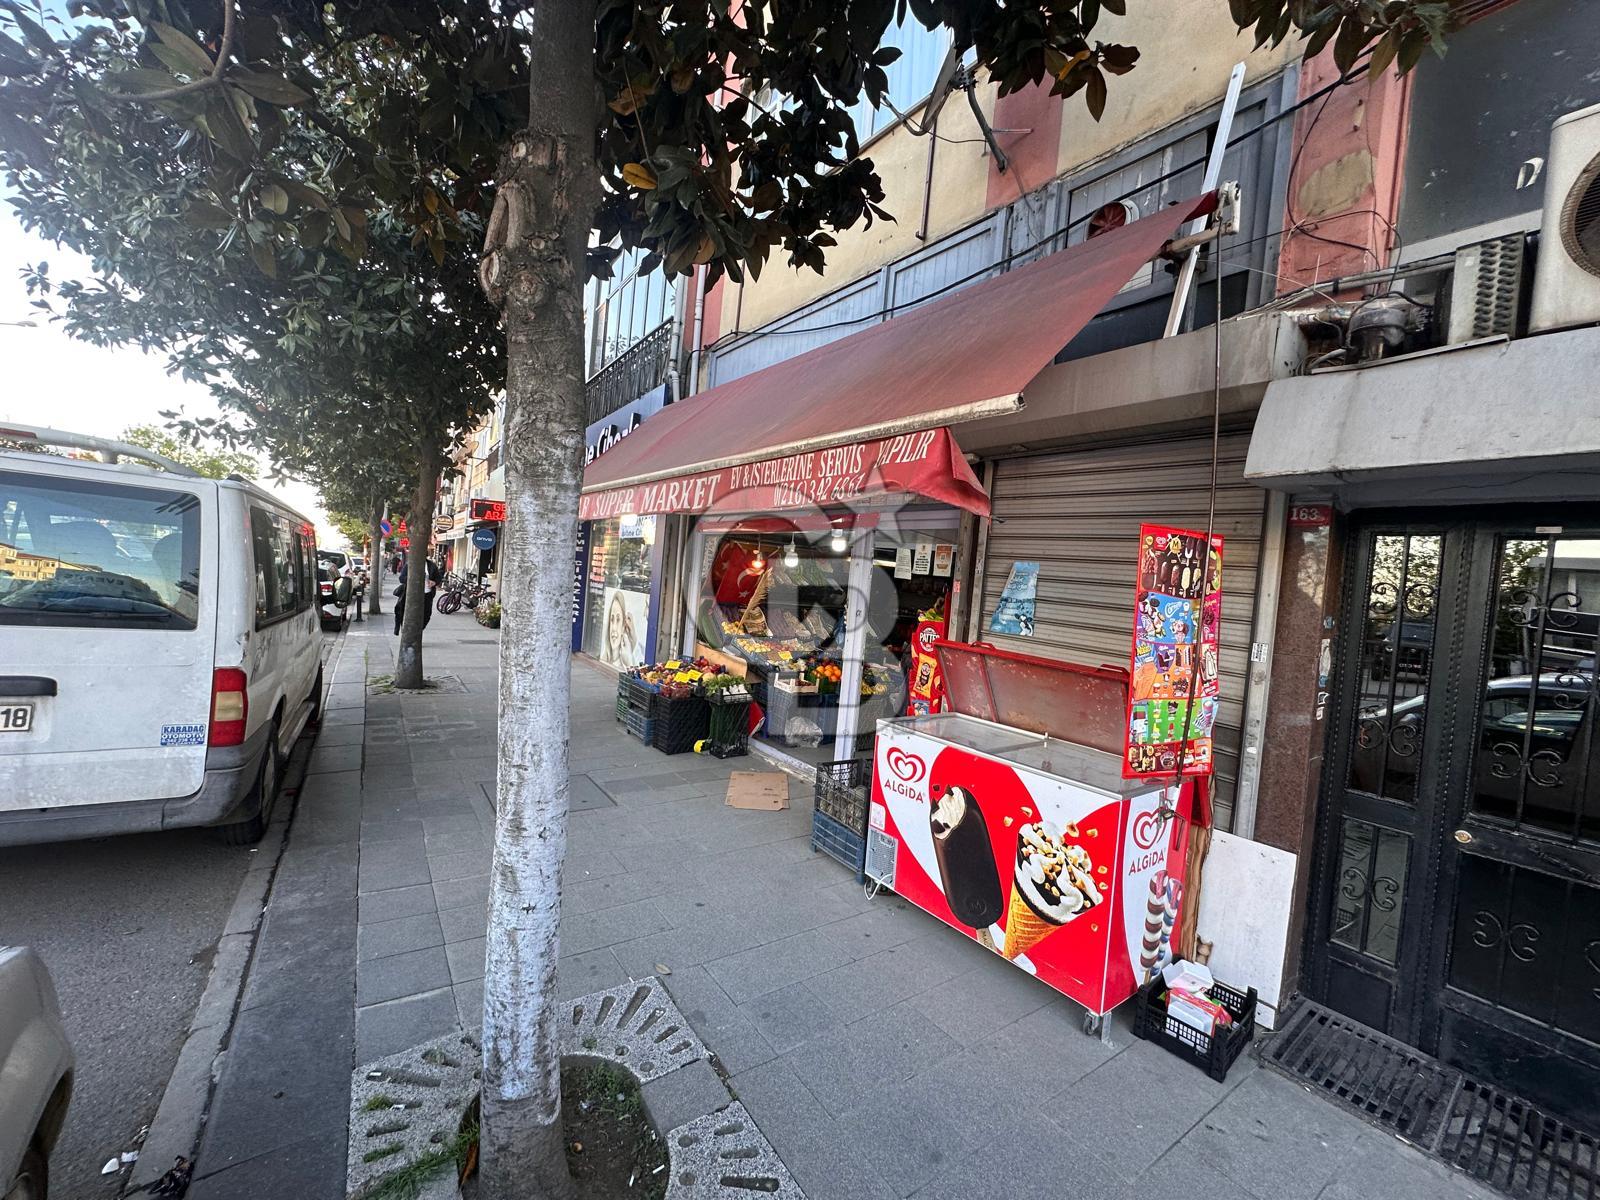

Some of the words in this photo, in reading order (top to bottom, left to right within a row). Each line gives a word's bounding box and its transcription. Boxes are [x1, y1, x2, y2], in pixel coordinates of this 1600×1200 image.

[730, 466, 742, 489] EV
[743, 464, 750, 488] &
[873, 430, 936, 469] YAPILIR
[640, 474, 721, 513] MARKET
[0, 707, 28, 728] 18
